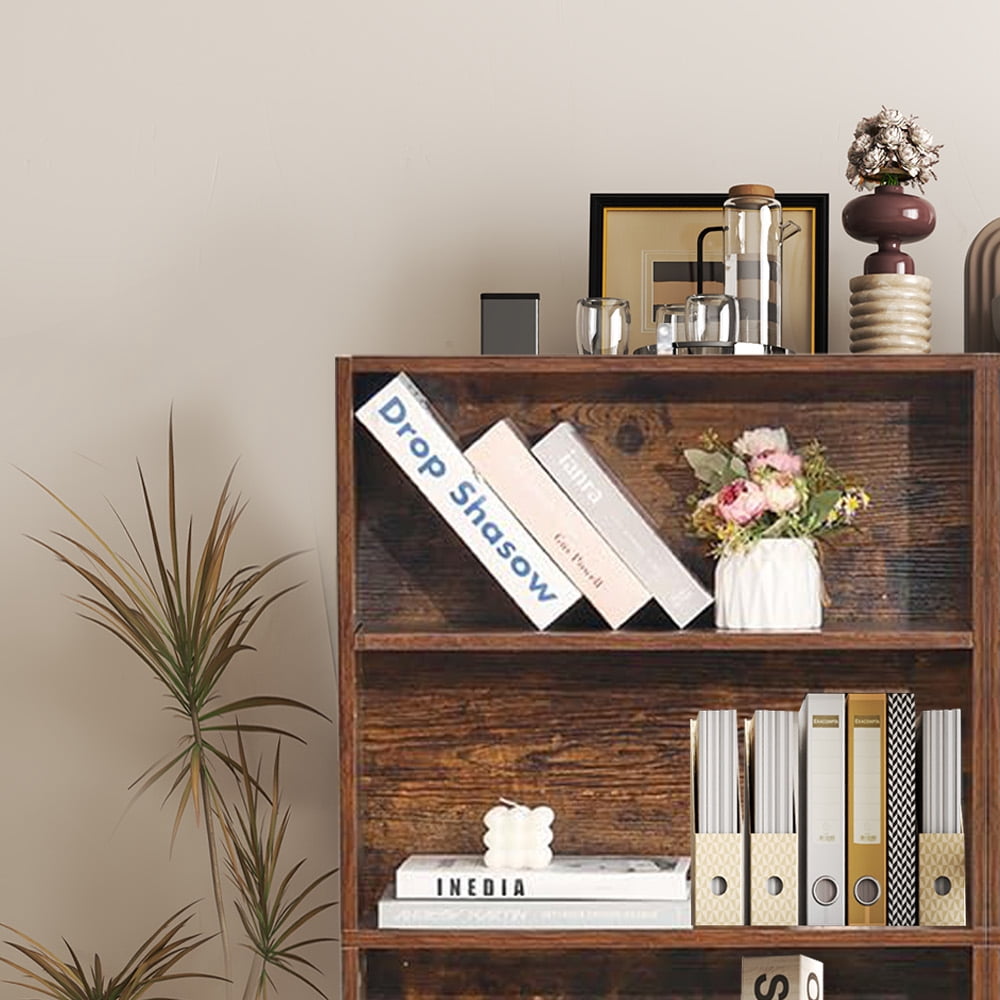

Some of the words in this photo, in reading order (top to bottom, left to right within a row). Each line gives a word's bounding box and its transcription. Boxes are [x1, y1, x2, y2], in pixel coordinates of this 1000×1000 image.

[377, 396, 446, 479] Drop
[451, 481, 556, 603] Shasow
[437, 878, 525, 897] INEDIA
